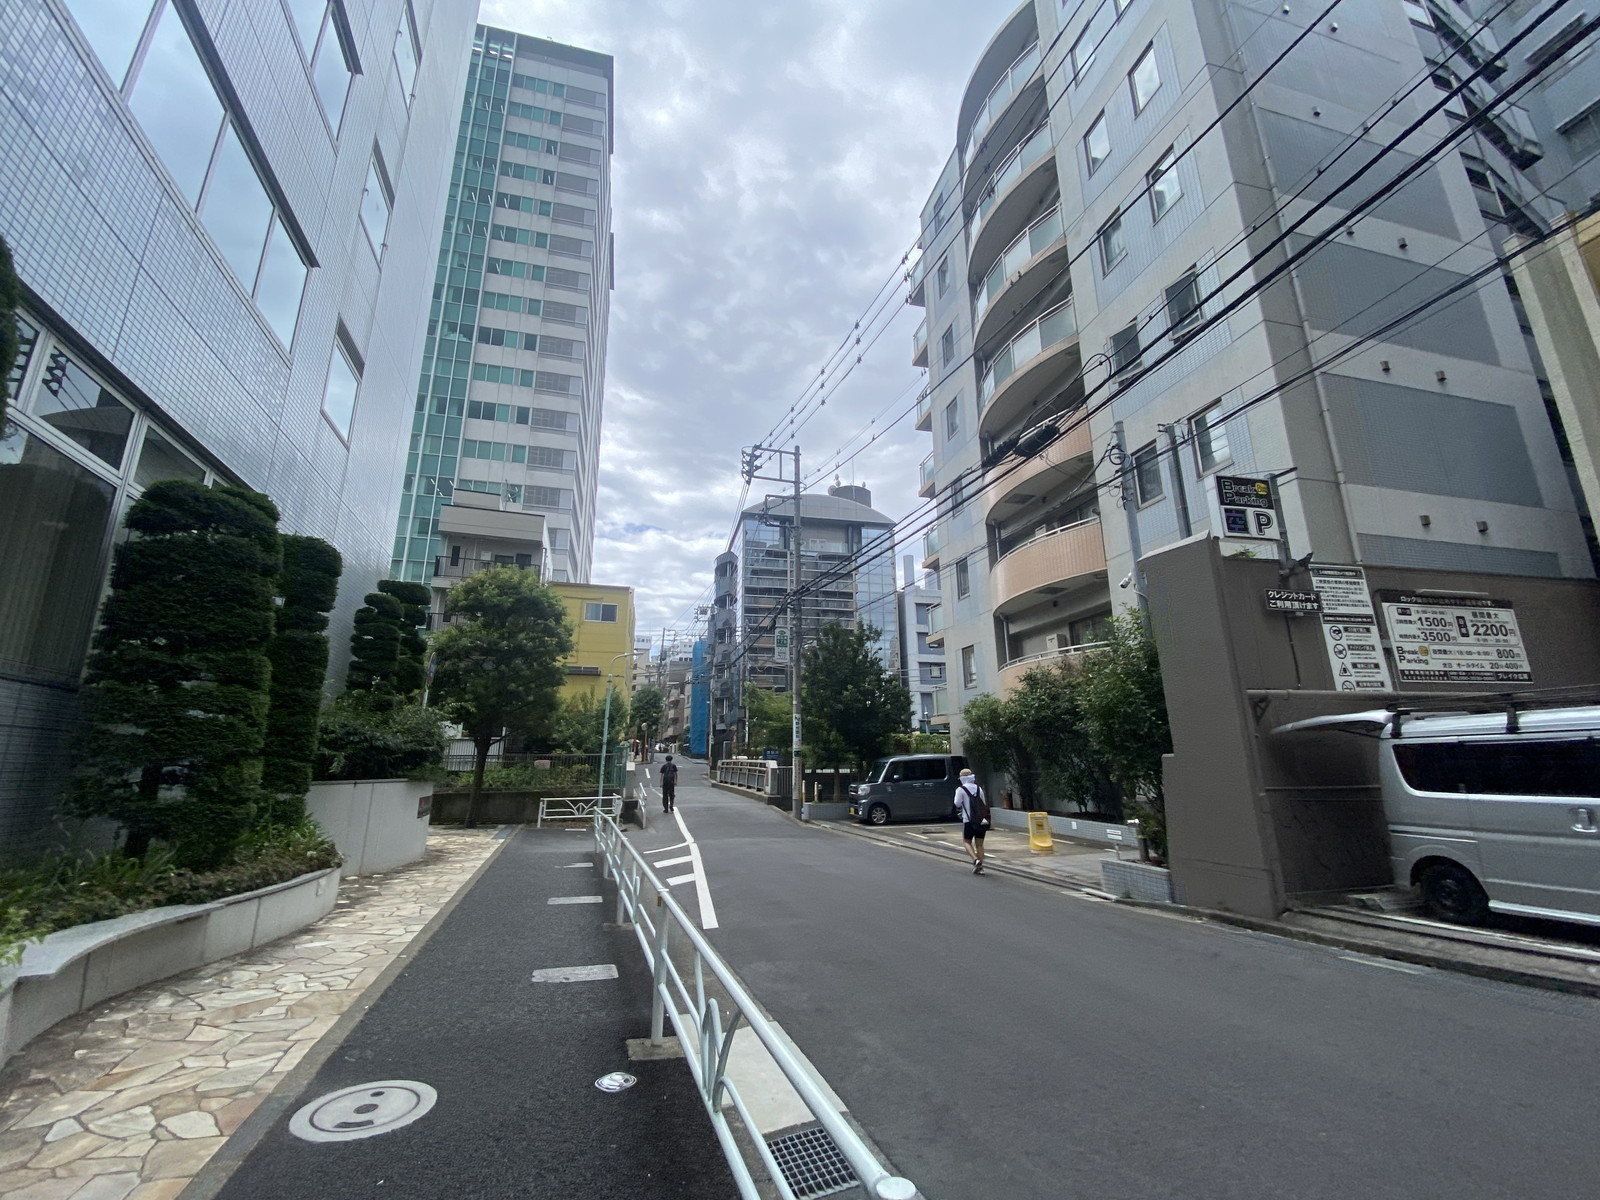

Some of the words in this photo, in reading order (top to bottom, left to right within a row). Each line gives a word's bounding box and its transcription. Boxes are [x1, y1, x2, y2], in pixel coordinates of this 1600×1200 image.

[1221, 479, 1256, 494] Break
[1224, 491, 1268, 507] Parking
[1253, 510, 1273, 536] P
[1268, 590, 1316, 601] クレジットカード
[1269, 600, 1319, 610] ご利用頂けます
[1396, 646, 1419, 655] Break
[1398, 655, 1429, 666] Parking
